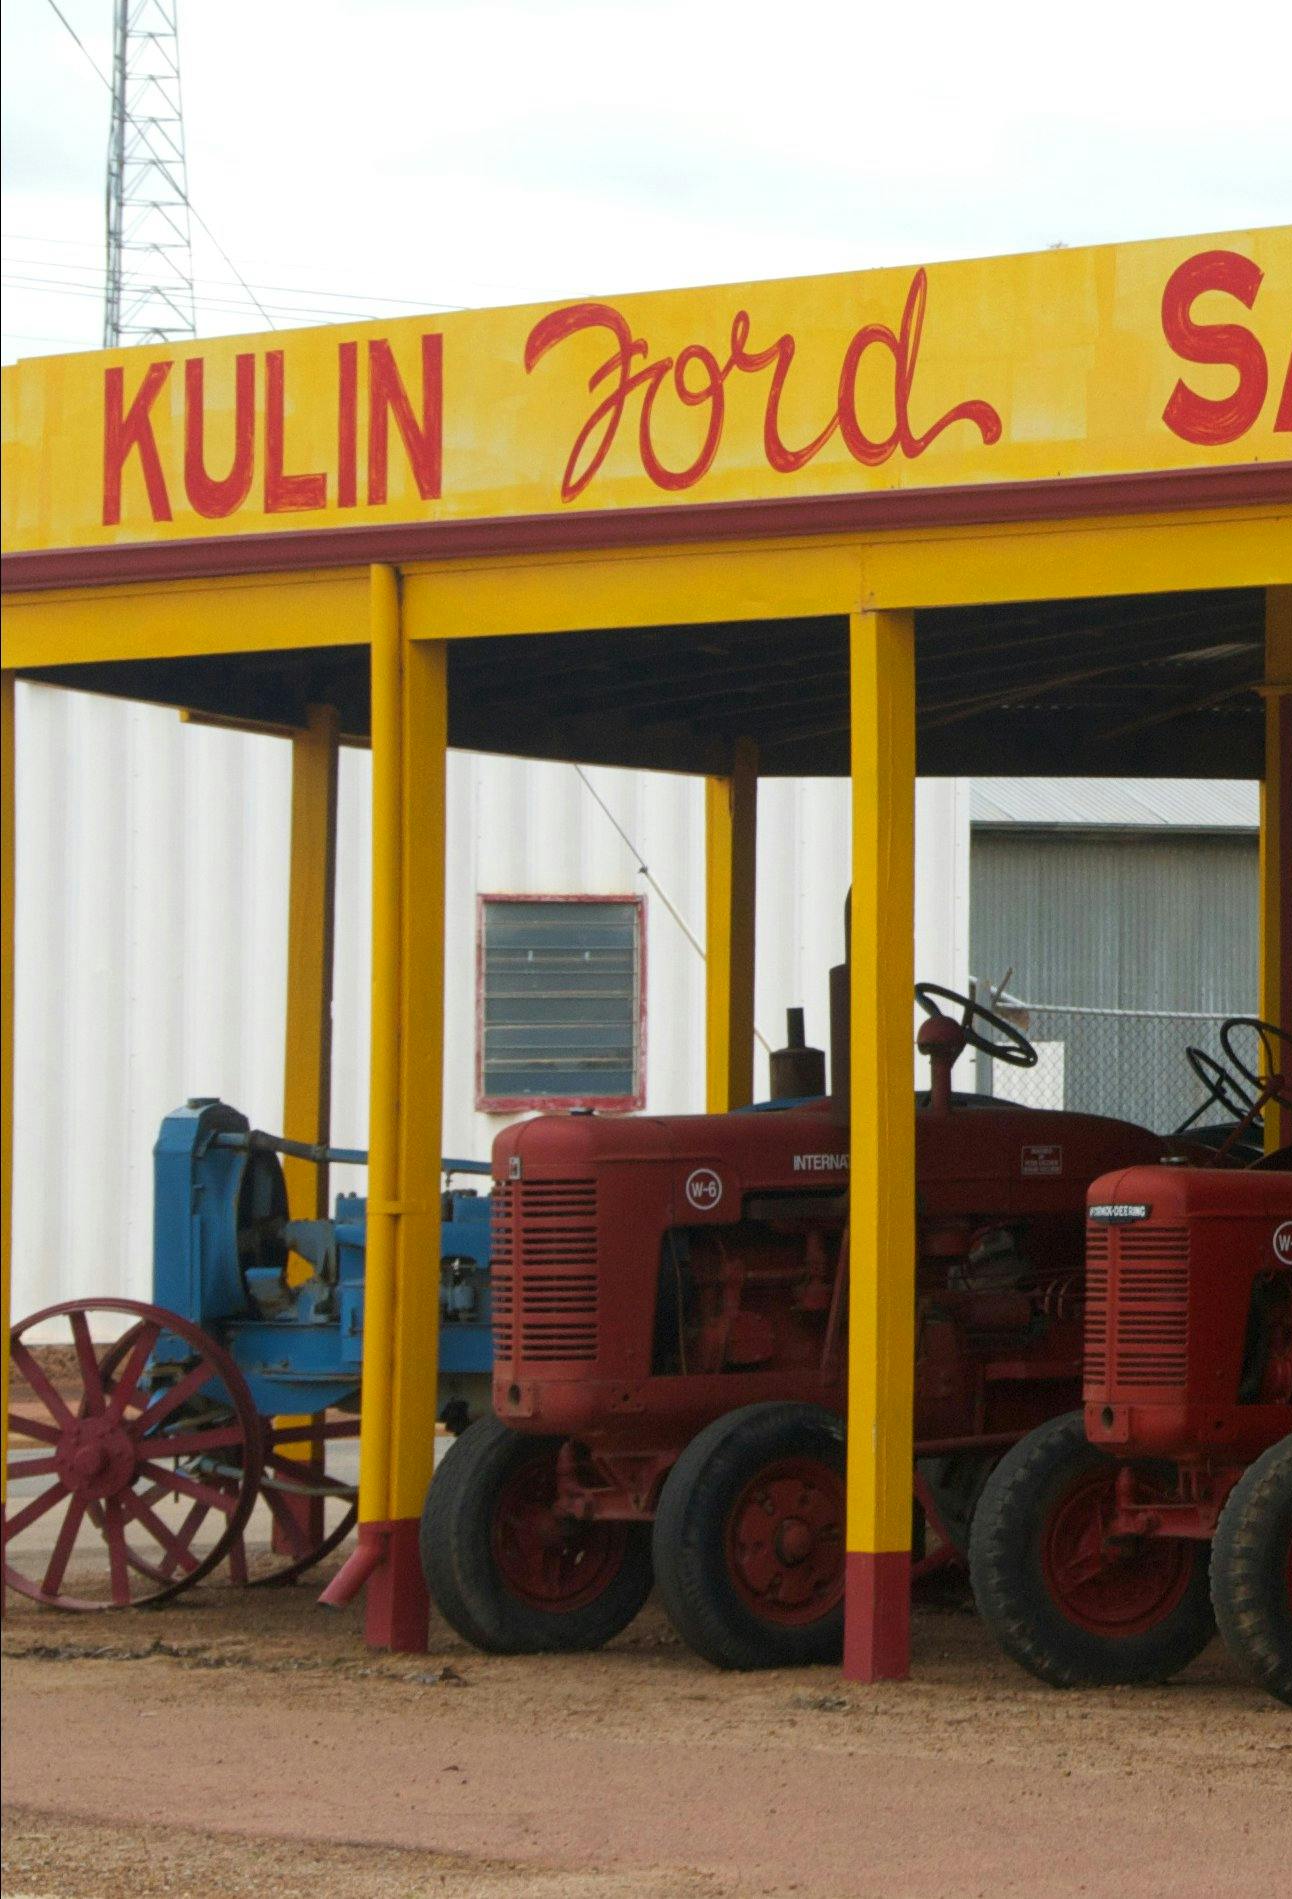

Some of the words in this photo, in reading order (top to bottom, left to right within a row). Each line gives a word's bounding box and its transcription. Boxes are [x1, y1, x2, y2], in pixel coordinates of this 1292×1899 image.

[104, 334, 442, 526] KULIN
[525, 266, 1002, 504] Ford
[691, 1181, 717, 1198] W-6
